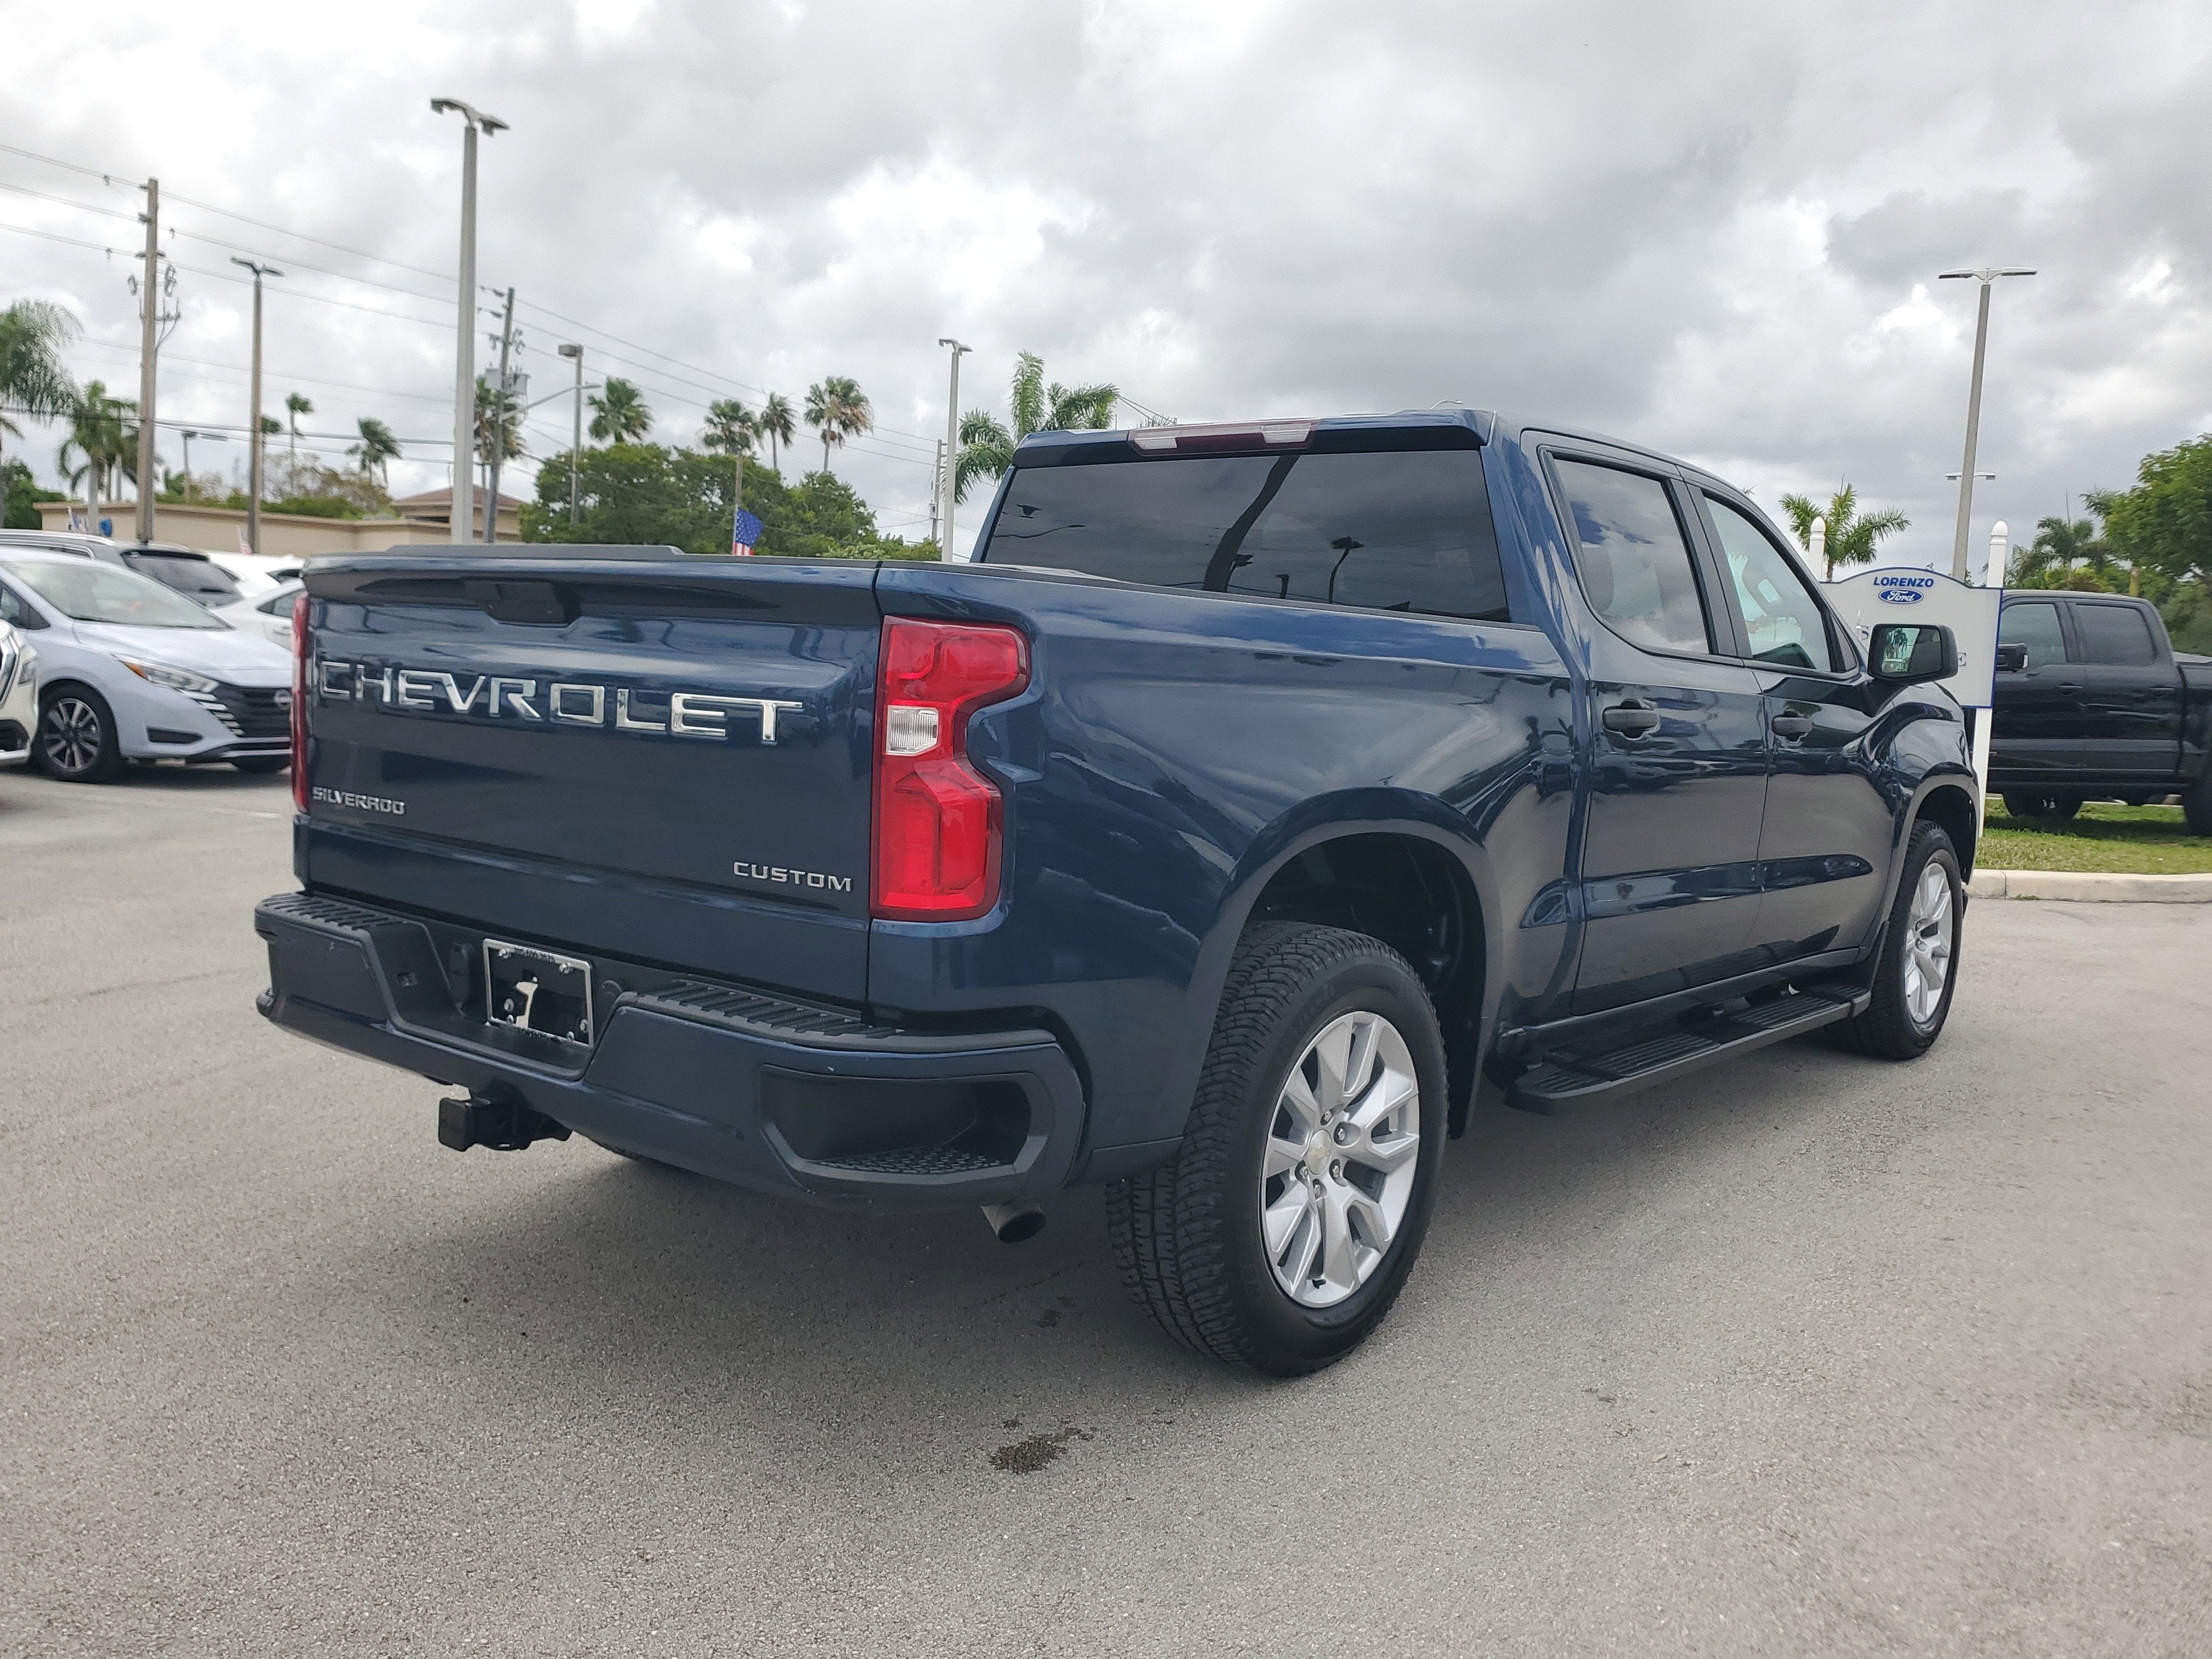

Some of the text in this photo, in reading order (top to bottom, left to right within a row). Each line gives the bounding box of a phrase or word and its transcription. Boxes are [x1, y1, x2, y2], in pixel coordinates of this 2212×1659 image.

[1873, 577, 1934, 588] LORENZO
[1887, 590, 1915, 602] Ford
[319, 661, 803, 743] CHEVROLET
[312, 786, 405, 815] SILVERADO
[733, 862, 852, 892] CUSTOM
